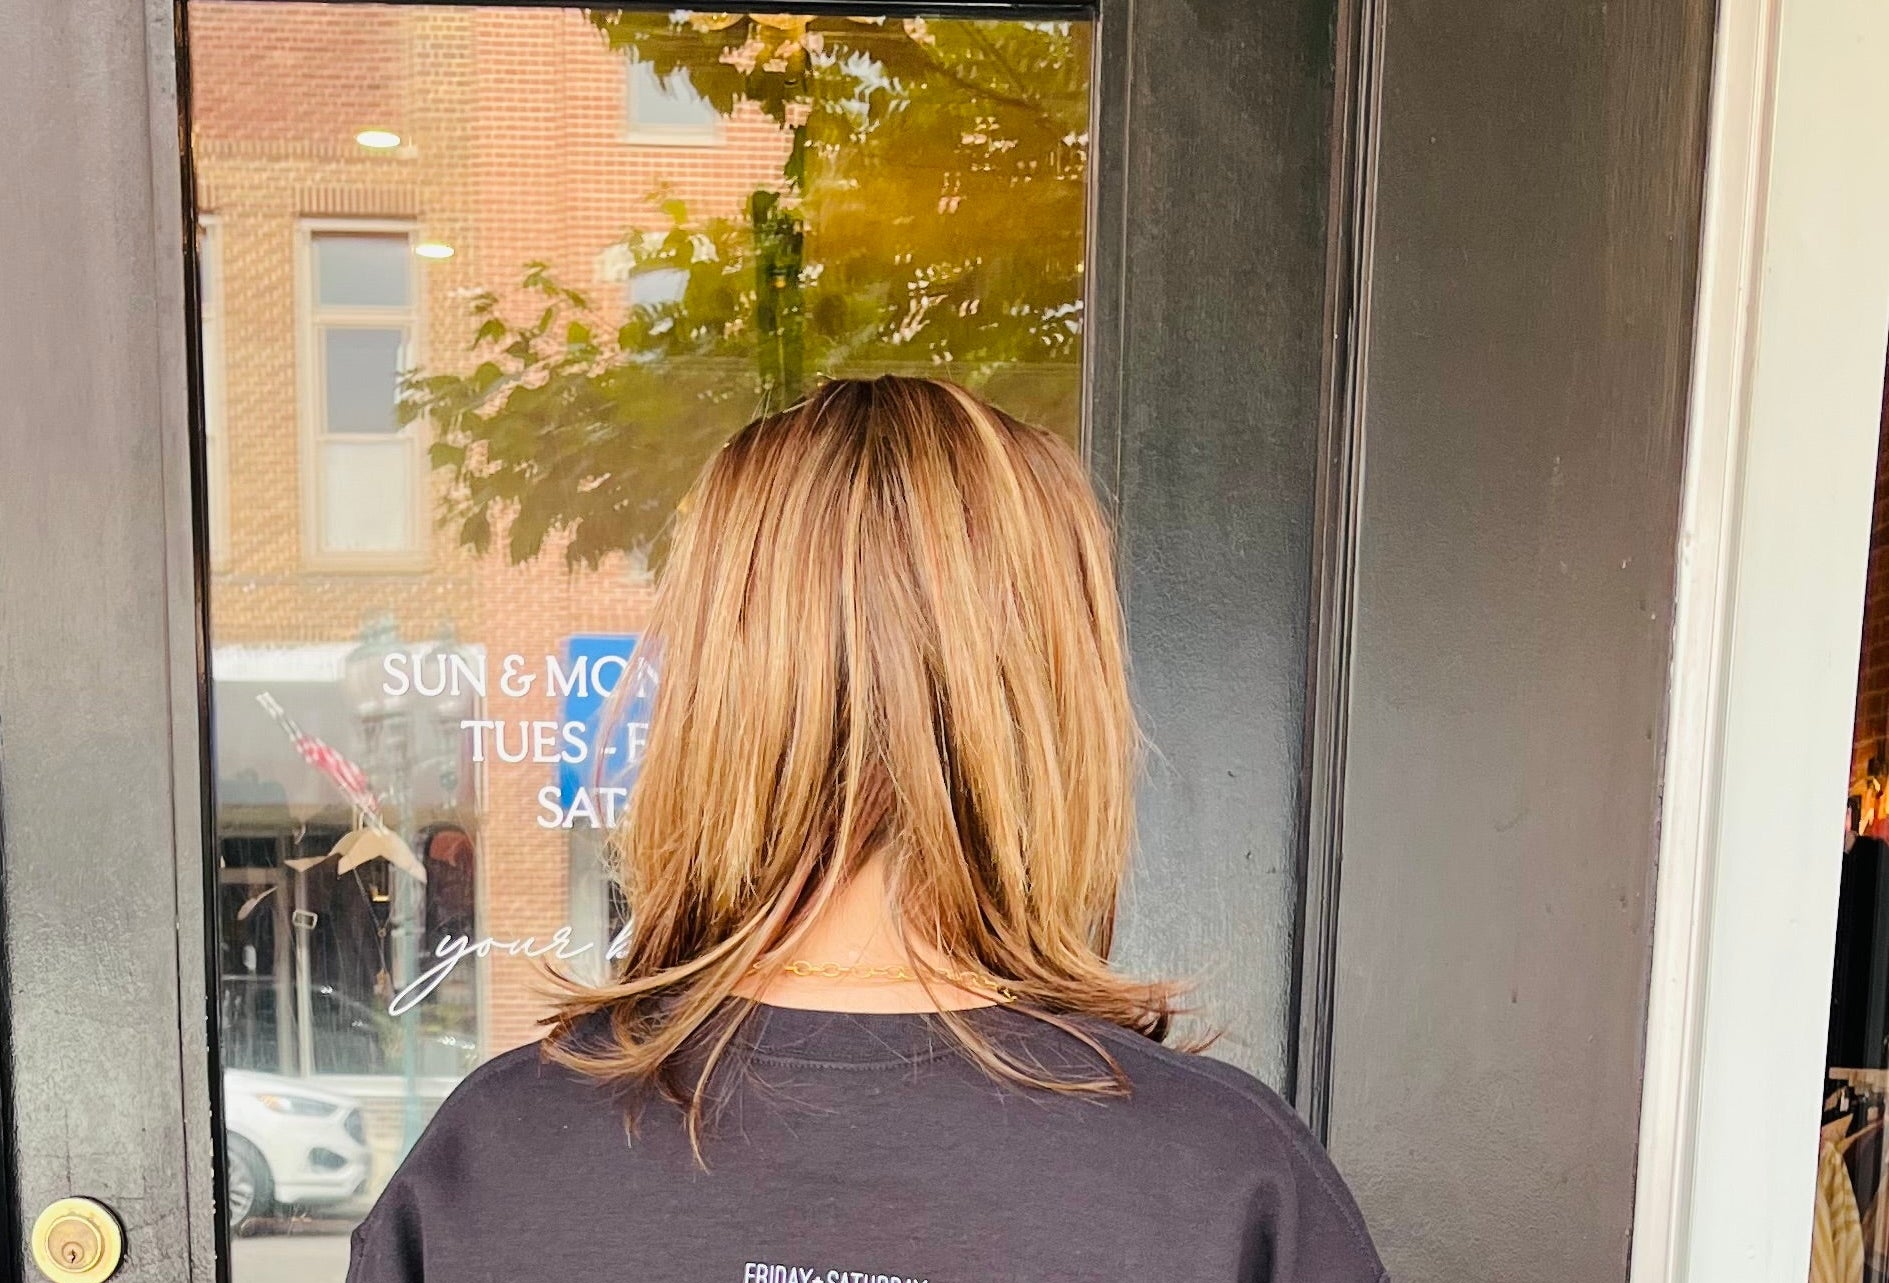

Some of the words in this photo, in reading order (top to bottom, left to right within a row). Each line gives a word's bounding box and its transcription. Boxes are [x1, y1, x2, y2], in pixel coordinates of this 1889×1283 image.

[382, 653, 486, 697] SUN
[500, 654, 537, 697] &
[460, 720, 587, 763] TUES
[388, 926, 594, 1016] your
